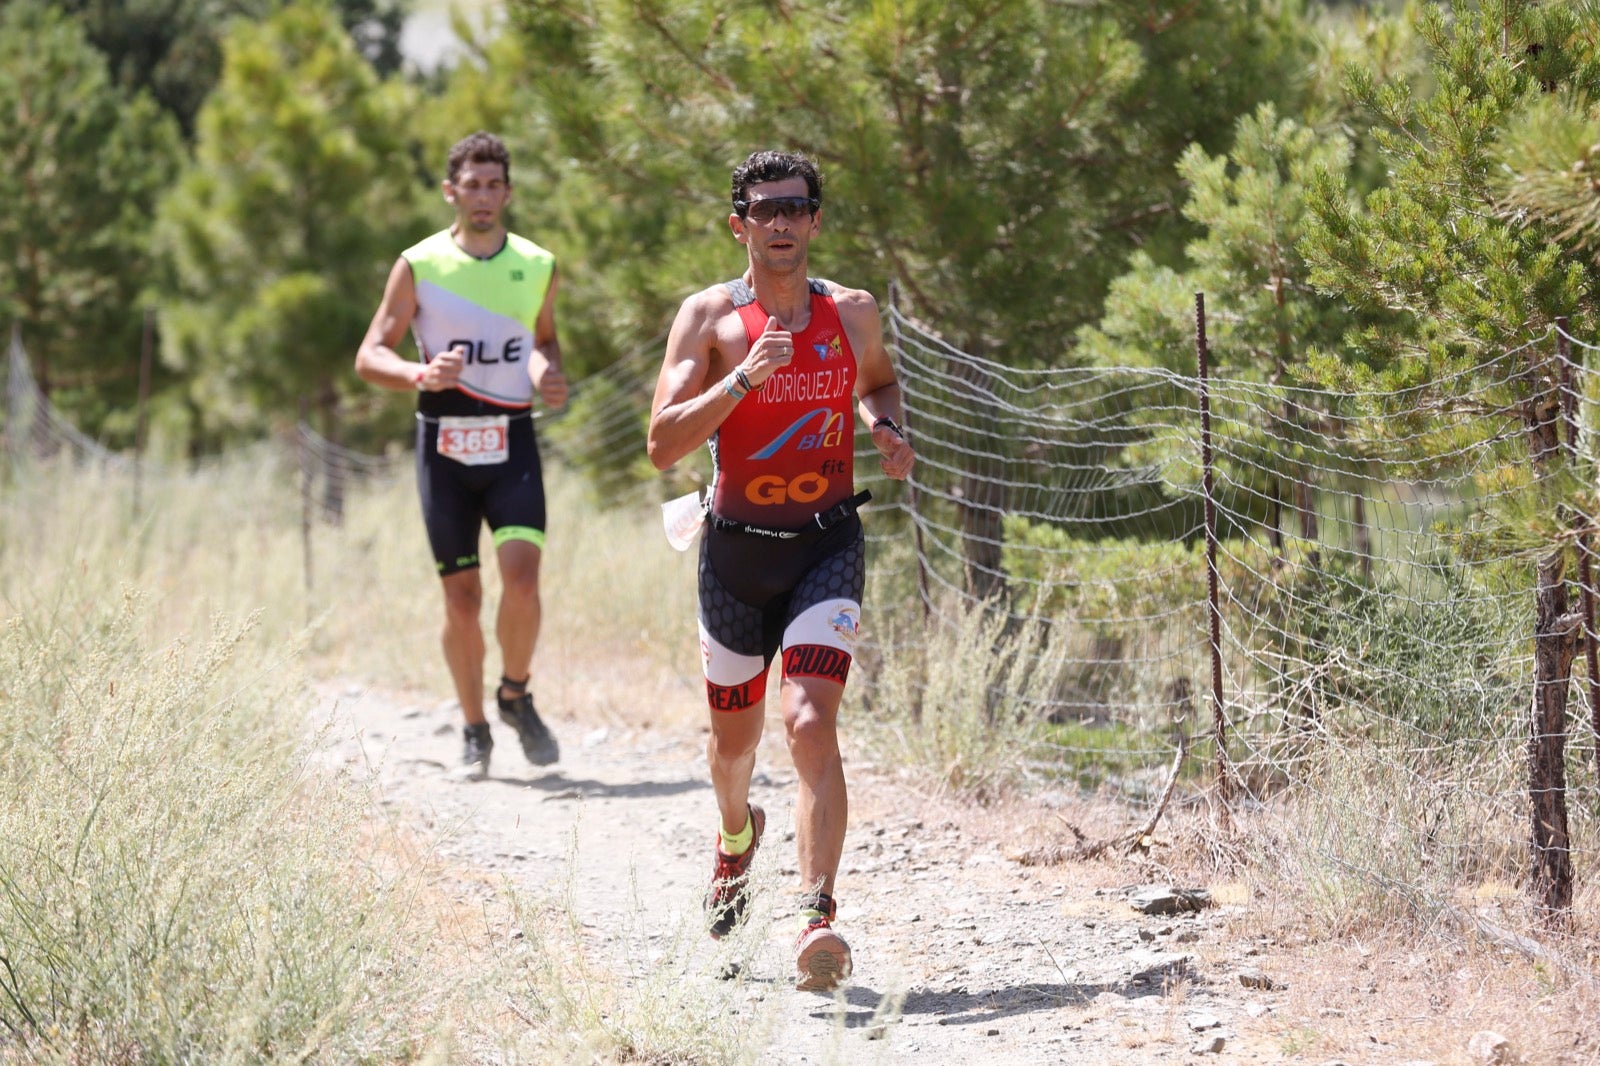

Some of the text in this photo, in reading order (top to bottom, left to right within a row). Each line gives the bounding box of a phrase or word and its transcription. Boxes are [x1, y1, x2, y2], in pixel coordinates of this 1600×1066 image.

[447, 429, 500, 452] 369
[797, 431, 842, 450] BICI
[745, 459, 845, 506] GO fit
[707, 683, 754, 711] REAL
